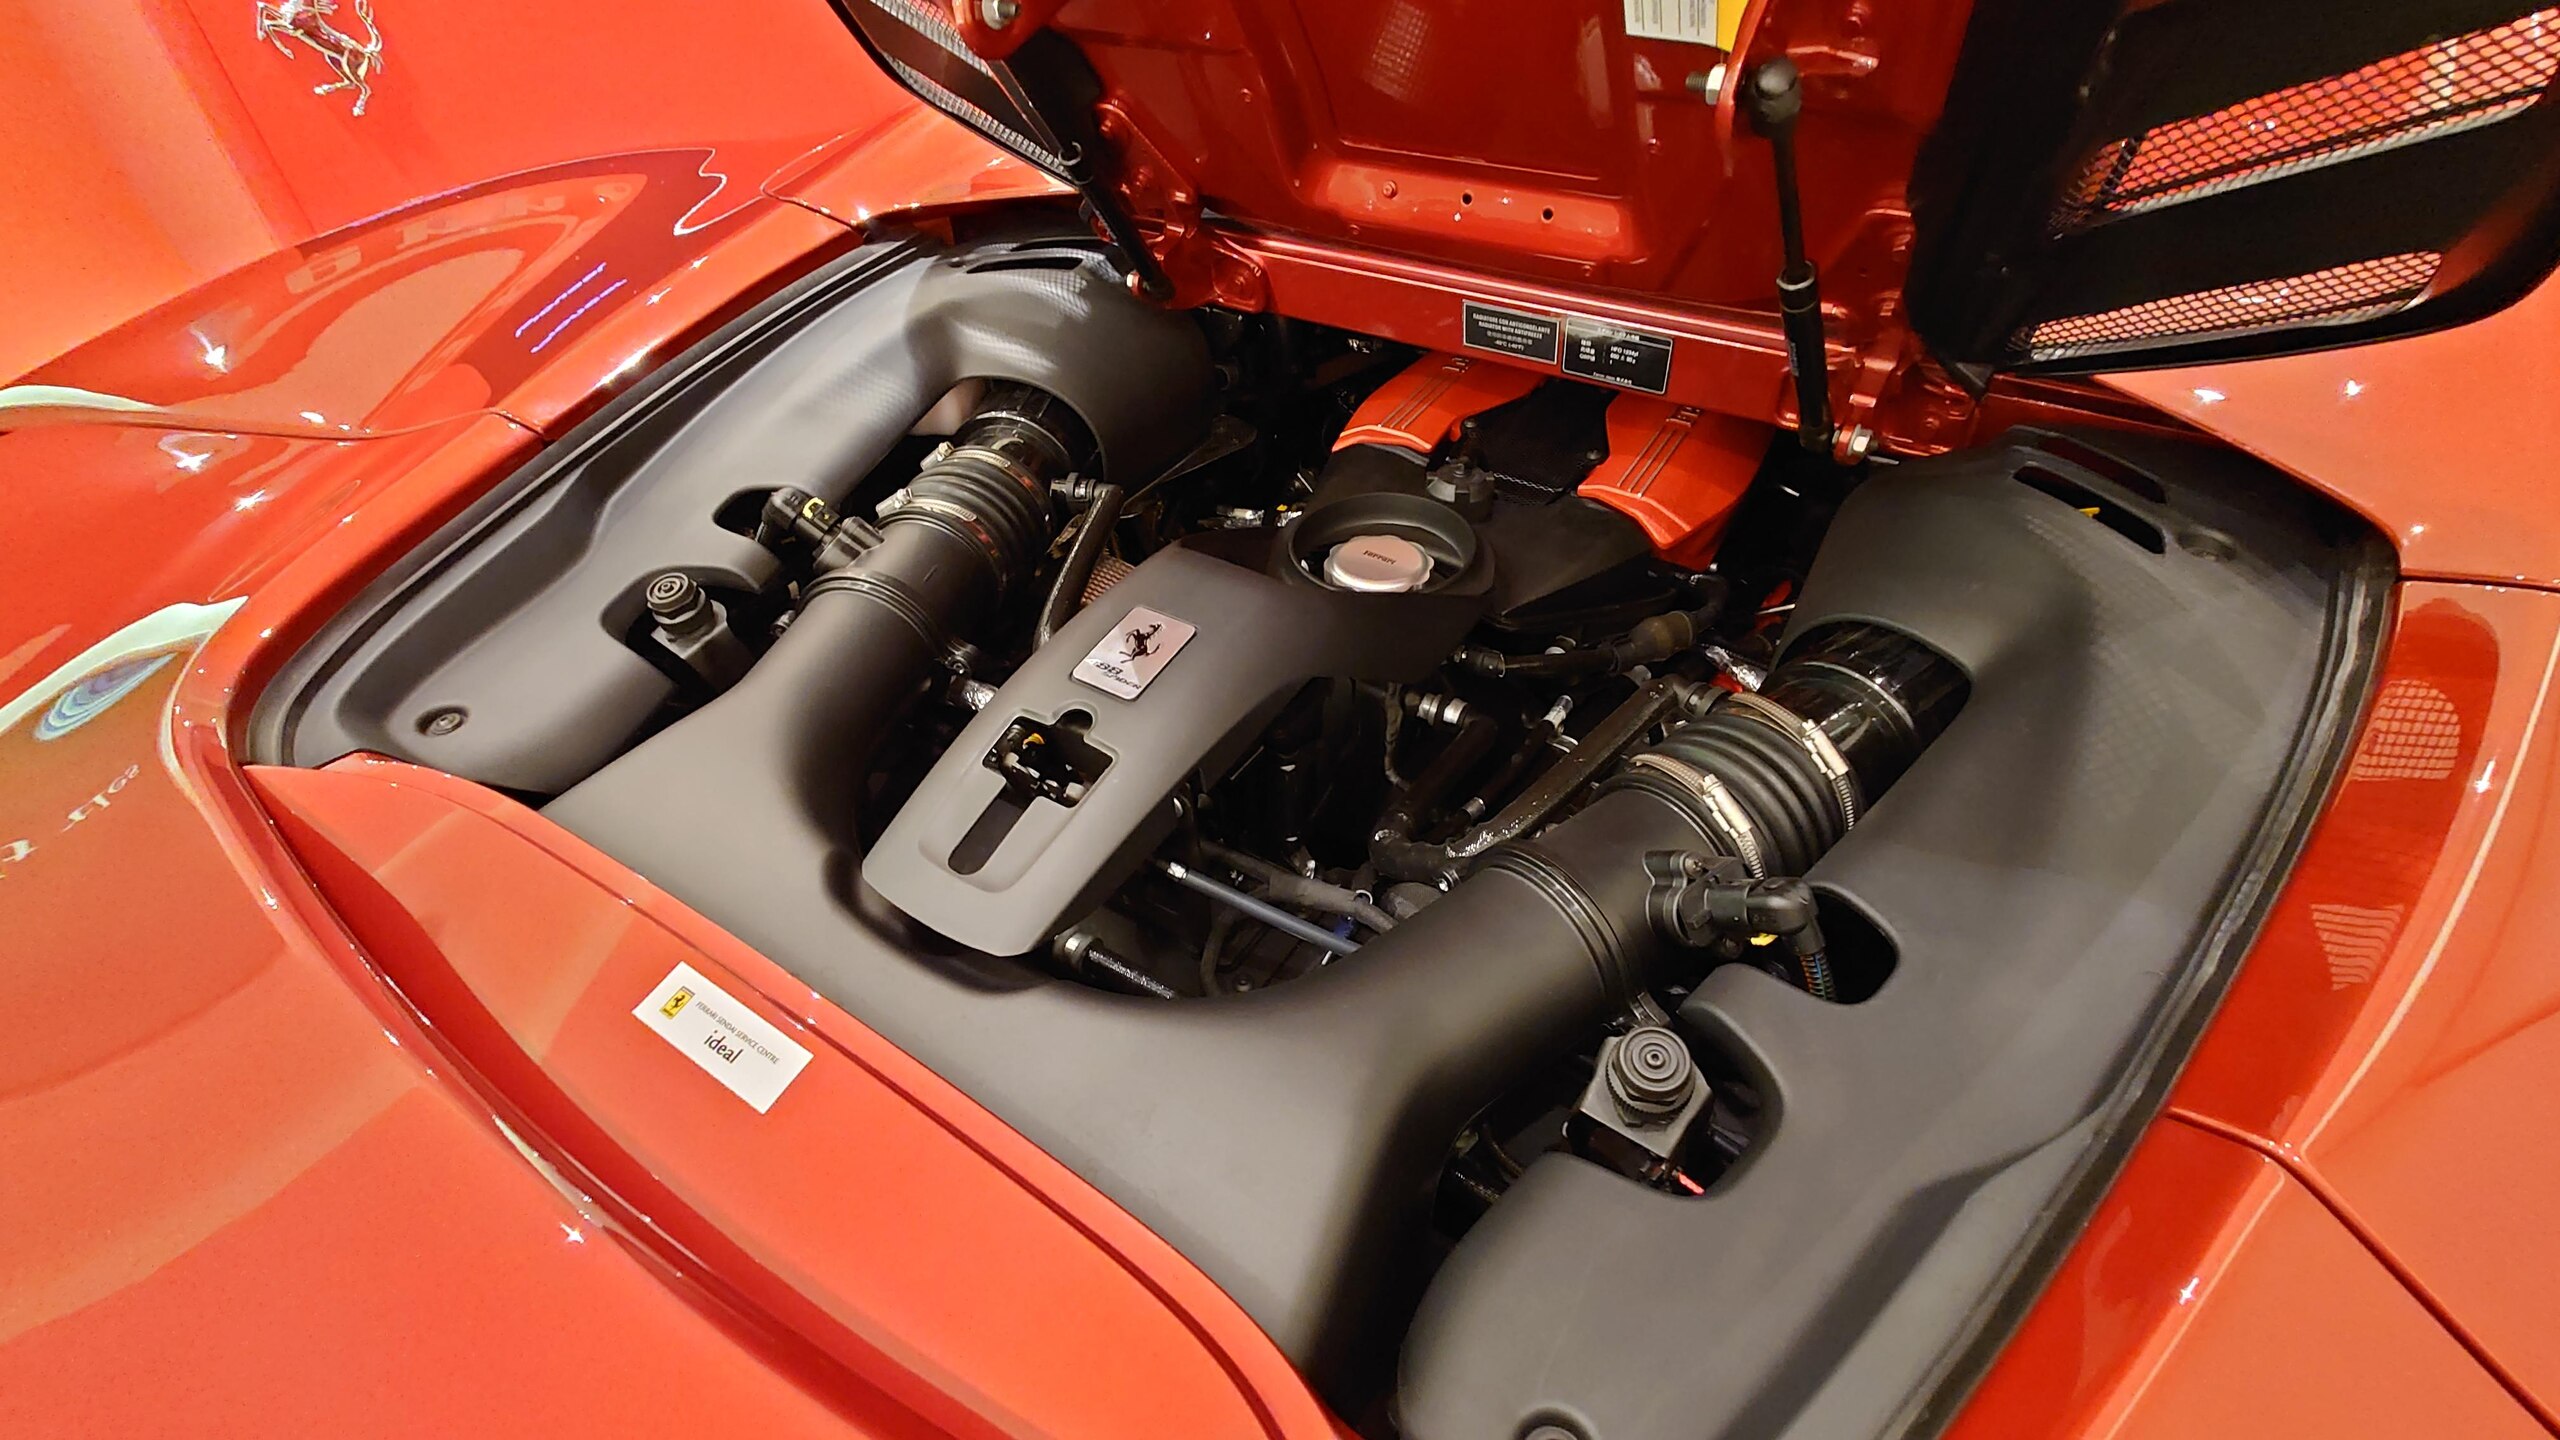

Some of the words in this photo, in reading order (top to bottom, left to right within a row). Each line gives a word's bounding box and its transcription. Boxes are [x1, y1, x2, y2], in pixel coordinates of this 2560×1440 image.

[1363, 549, 1397, 565] Ferrari
[696, 1001, 719, 1020] FERRARI
[717, 1016, 738, 1034] SENDAI
[735, 1030, 759, 1049] SERVICE
[756, 1045, 780, 1065] CENTRE
[703, 1029, 744, 1064] ideal
